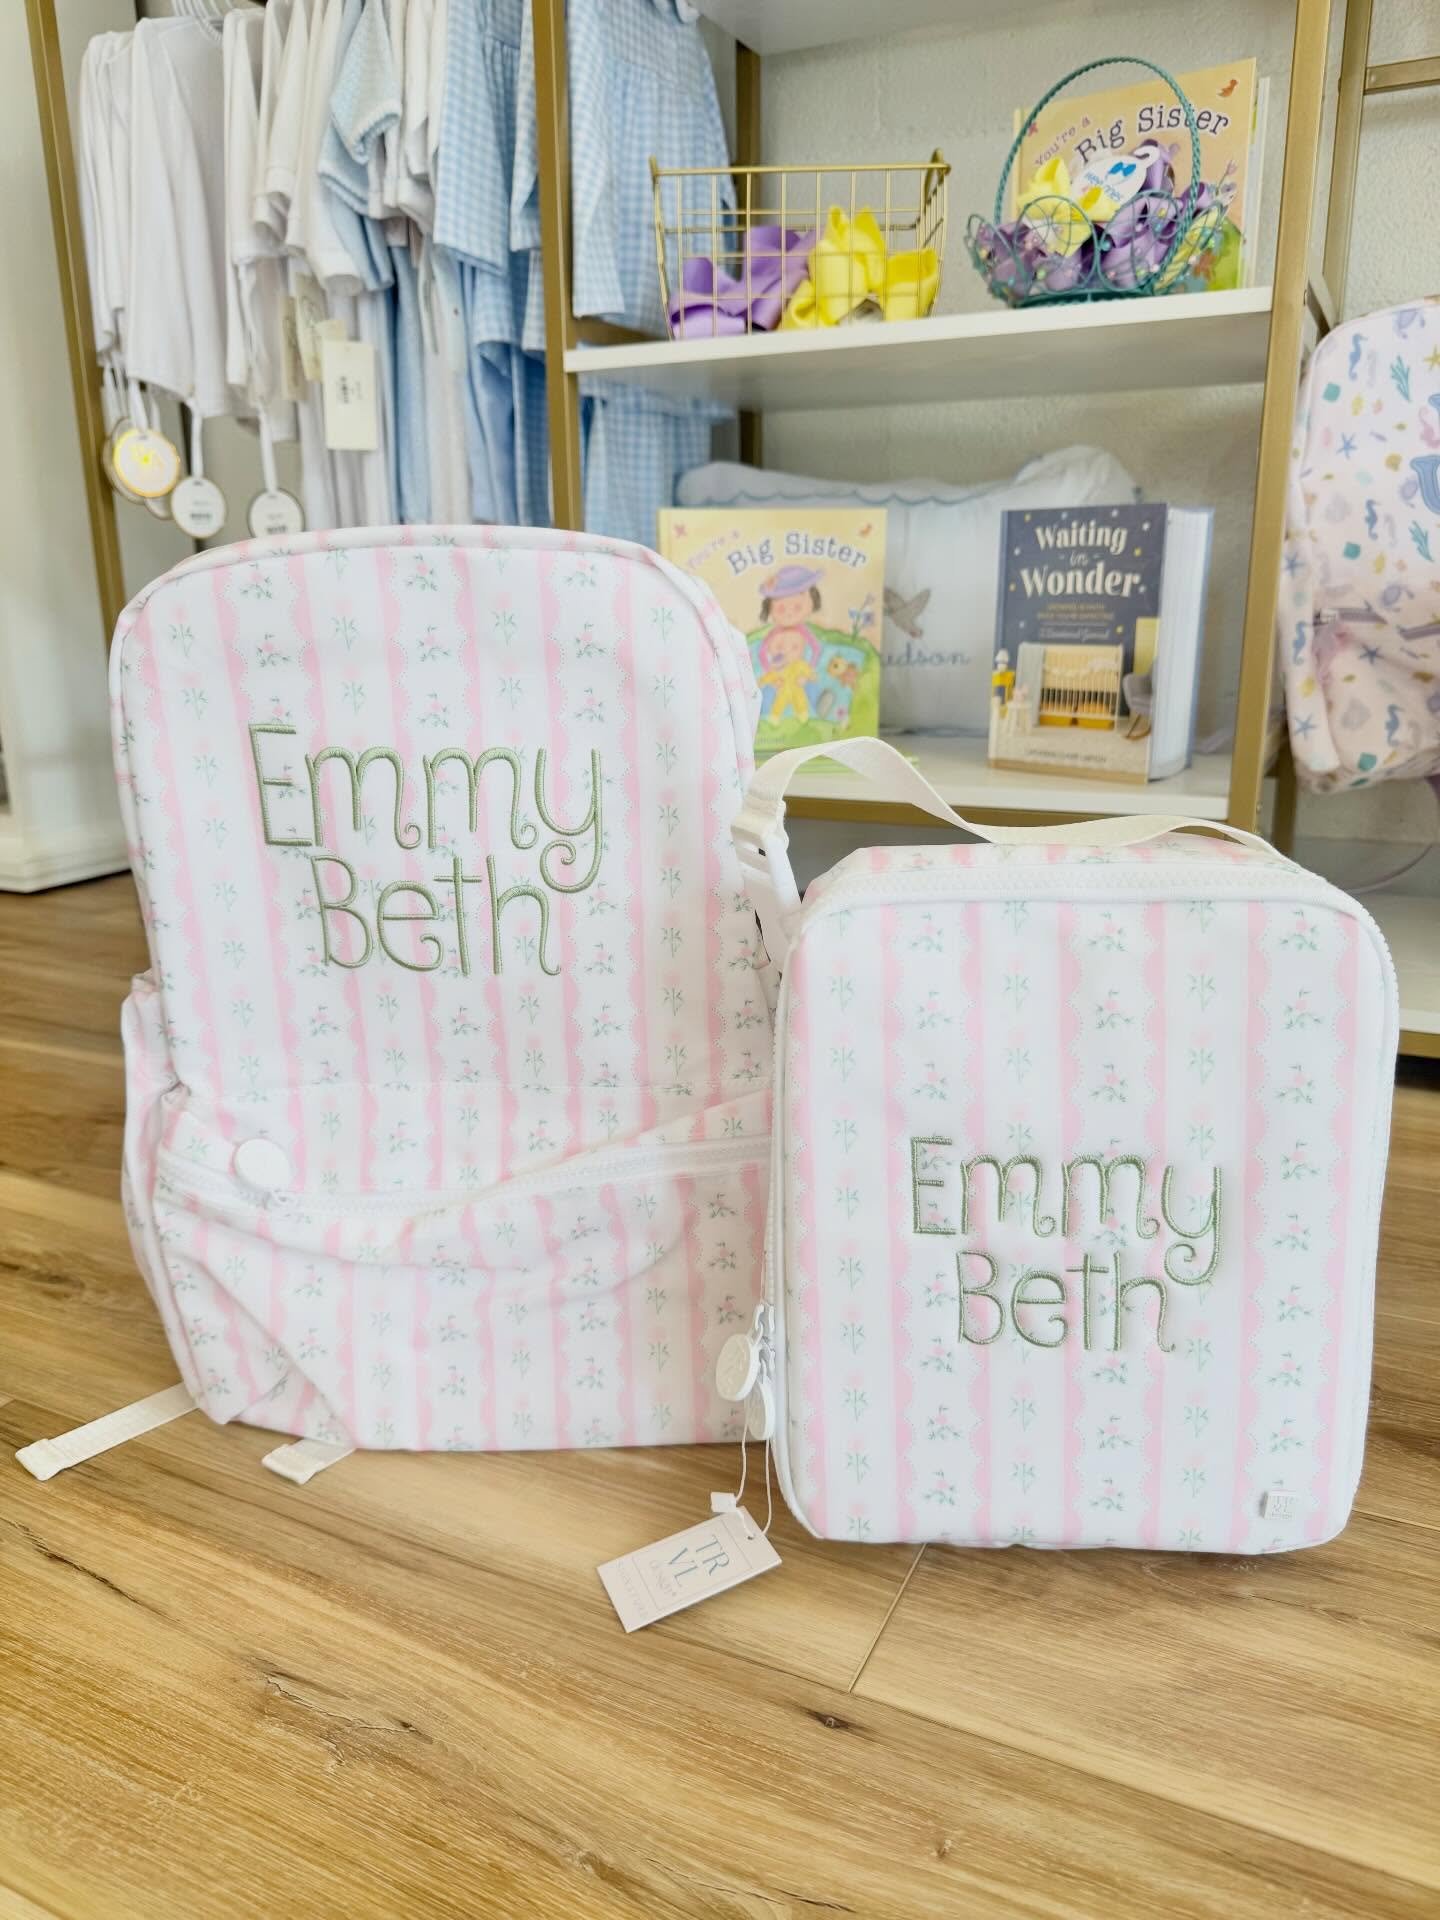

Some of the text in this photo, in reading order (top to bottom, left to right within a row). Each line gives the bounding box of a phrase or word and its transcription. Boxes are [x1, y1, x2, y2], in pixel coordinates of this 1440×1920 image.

[727, 531, 867, 575] Big Sister
[1020, 561, 1140, 598] Wonder
[1035, 520, 1128, 555] Waiting
[249, 723, 602, 893] Emmy
[311, 854, 562, 977] Beth
[911, 1136, 1223, 1286] Emmy
[956, 1250, 1176, 1353] Beth
